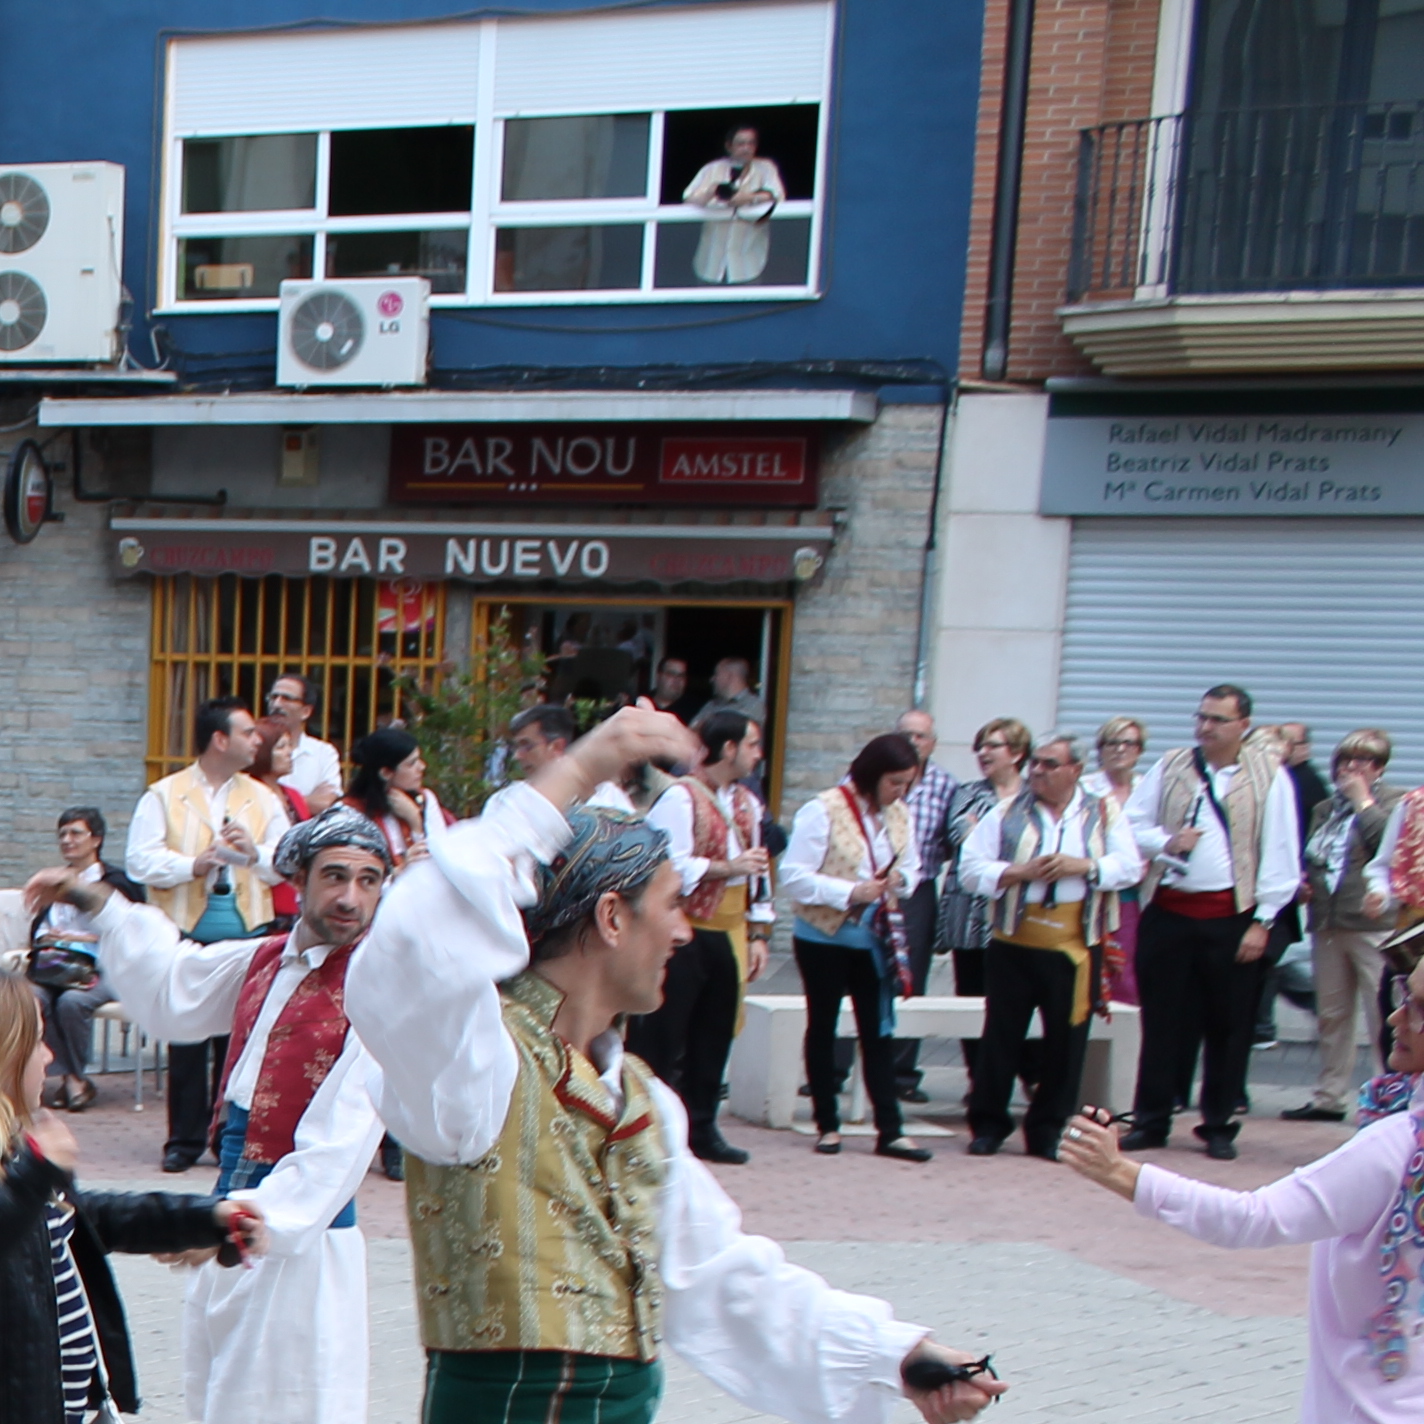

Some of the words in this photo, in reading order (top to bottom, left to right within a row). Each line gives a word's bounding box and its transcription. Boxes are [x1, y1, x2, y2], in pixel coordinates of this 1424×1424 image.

[379, 320, 401, 334] LG
[1109, 423, 1178, 443] Rafael
[1188, 424, 1247, 443] Vidal
[1257, 422, 1401, 447] Madramany
[422, 437, 514, 476] BAR
[529, 437, 637, 476] NOU
[671, 452, 789, 477] AMSTEL
[1107, 453, 1190, 473] Beatriz
[1200, 452, 1258, 473] Vidal
[1266, 453, 1330, 473] Prats
[1144, 481, 1240, 501] Carmen
[1250, 481, 1309, 502] Vidal
[1318, 482, 1382, 501] Prats
[309, 537, 407, 573] BAR
[445, 538, 610, 578] NUEVO
